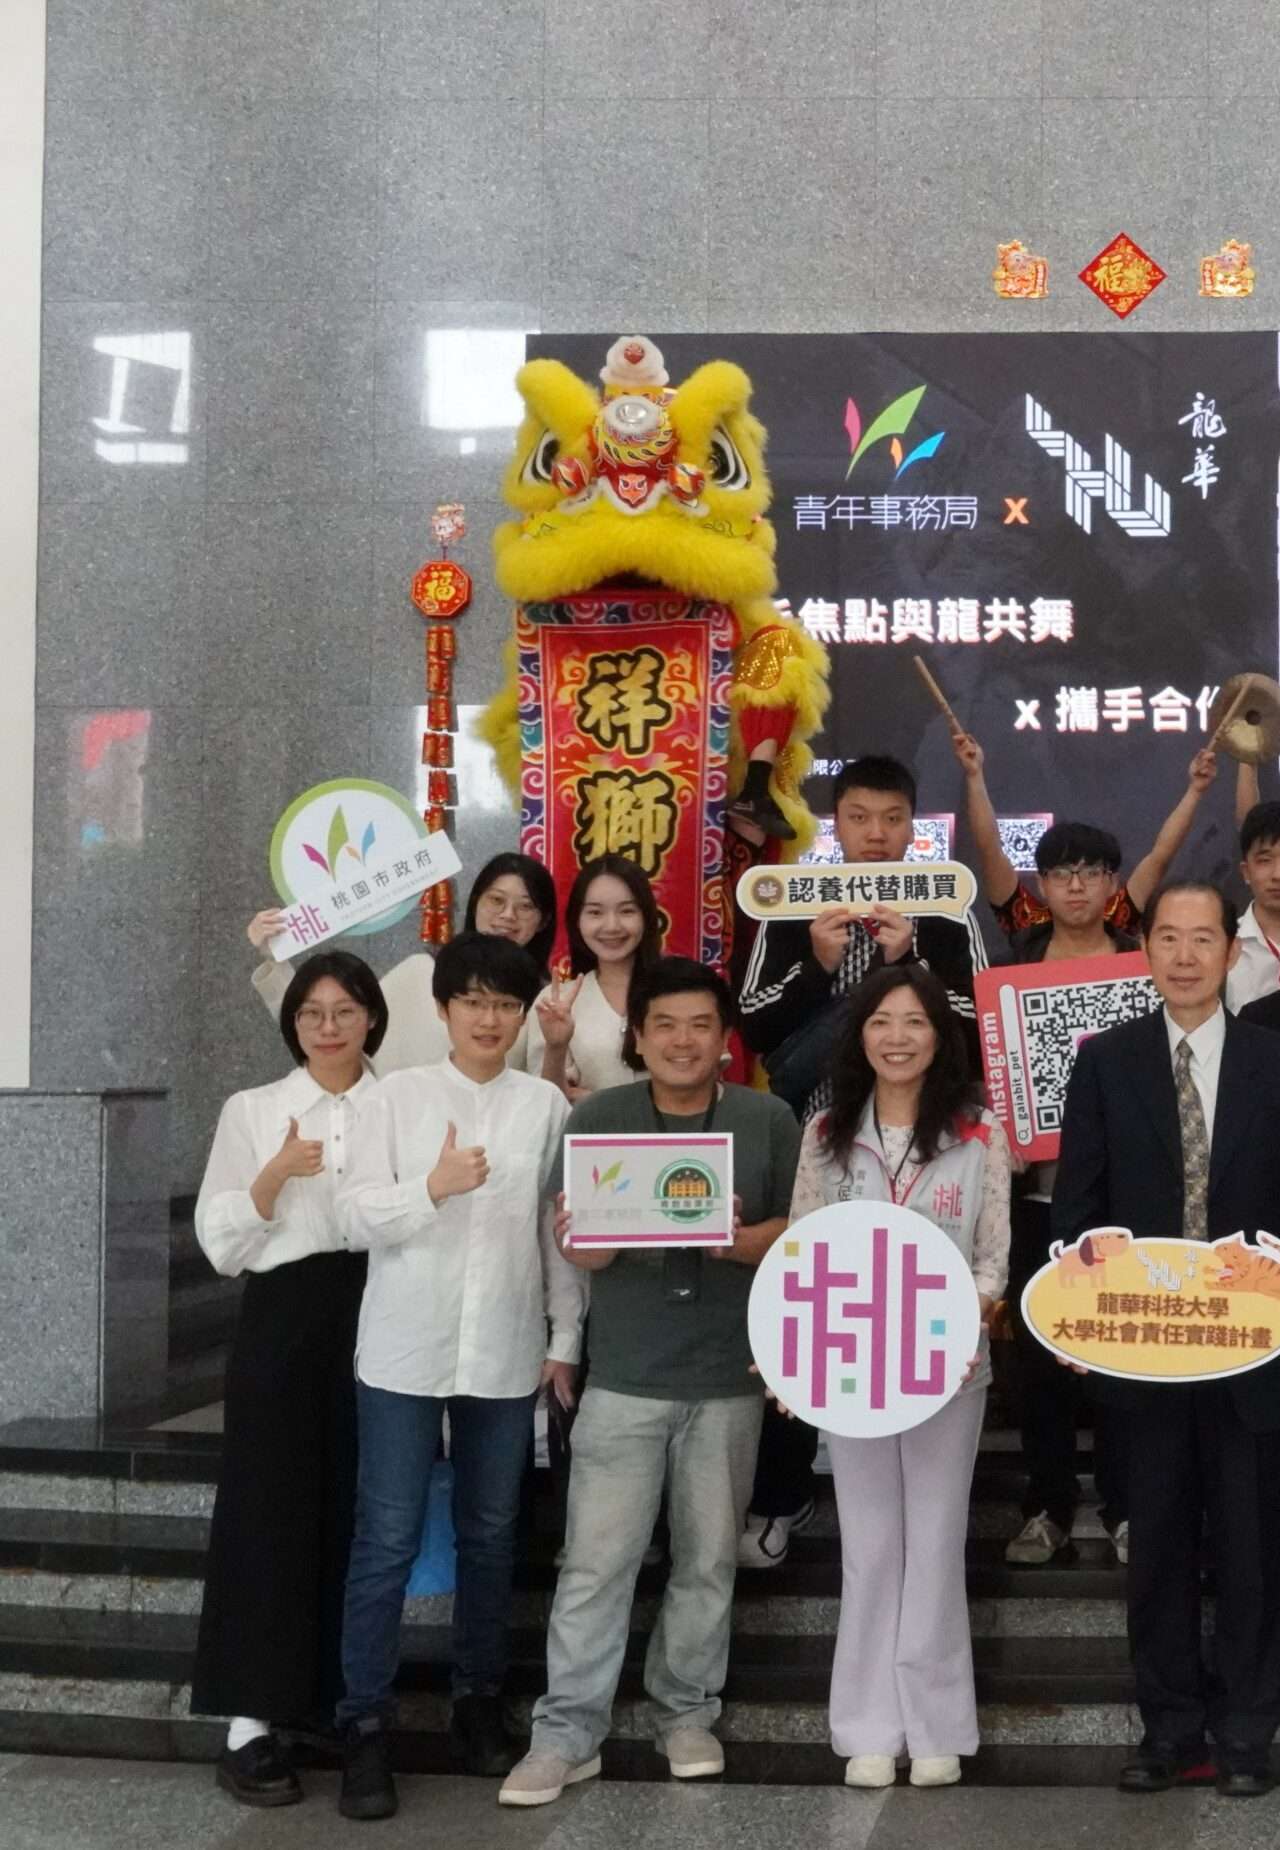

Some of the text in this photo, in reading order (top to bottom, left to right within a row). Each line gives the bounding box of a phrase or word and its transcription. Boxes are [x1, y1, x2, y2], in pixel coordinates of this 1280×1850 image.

[1179, 392, 1227, 500] 龍華
[793, 494, 978, 531] 青年事務局
[424, 570, 456, 600] 福
[807, 759, 856, 776] 限公
[331, 848, 432, 911] 桃園市政府
[788, 874, 957, 903] 認養代替購買
[982, 1012, 1008, 1121] Instagram
[1009, 1050, 1029, 1120] gaiabit_pet
[1097, 1292, 1229, 1319] 龍華科技大學
[1053, 1319, 1272, 1349] 大學社會責任實踐計畫
